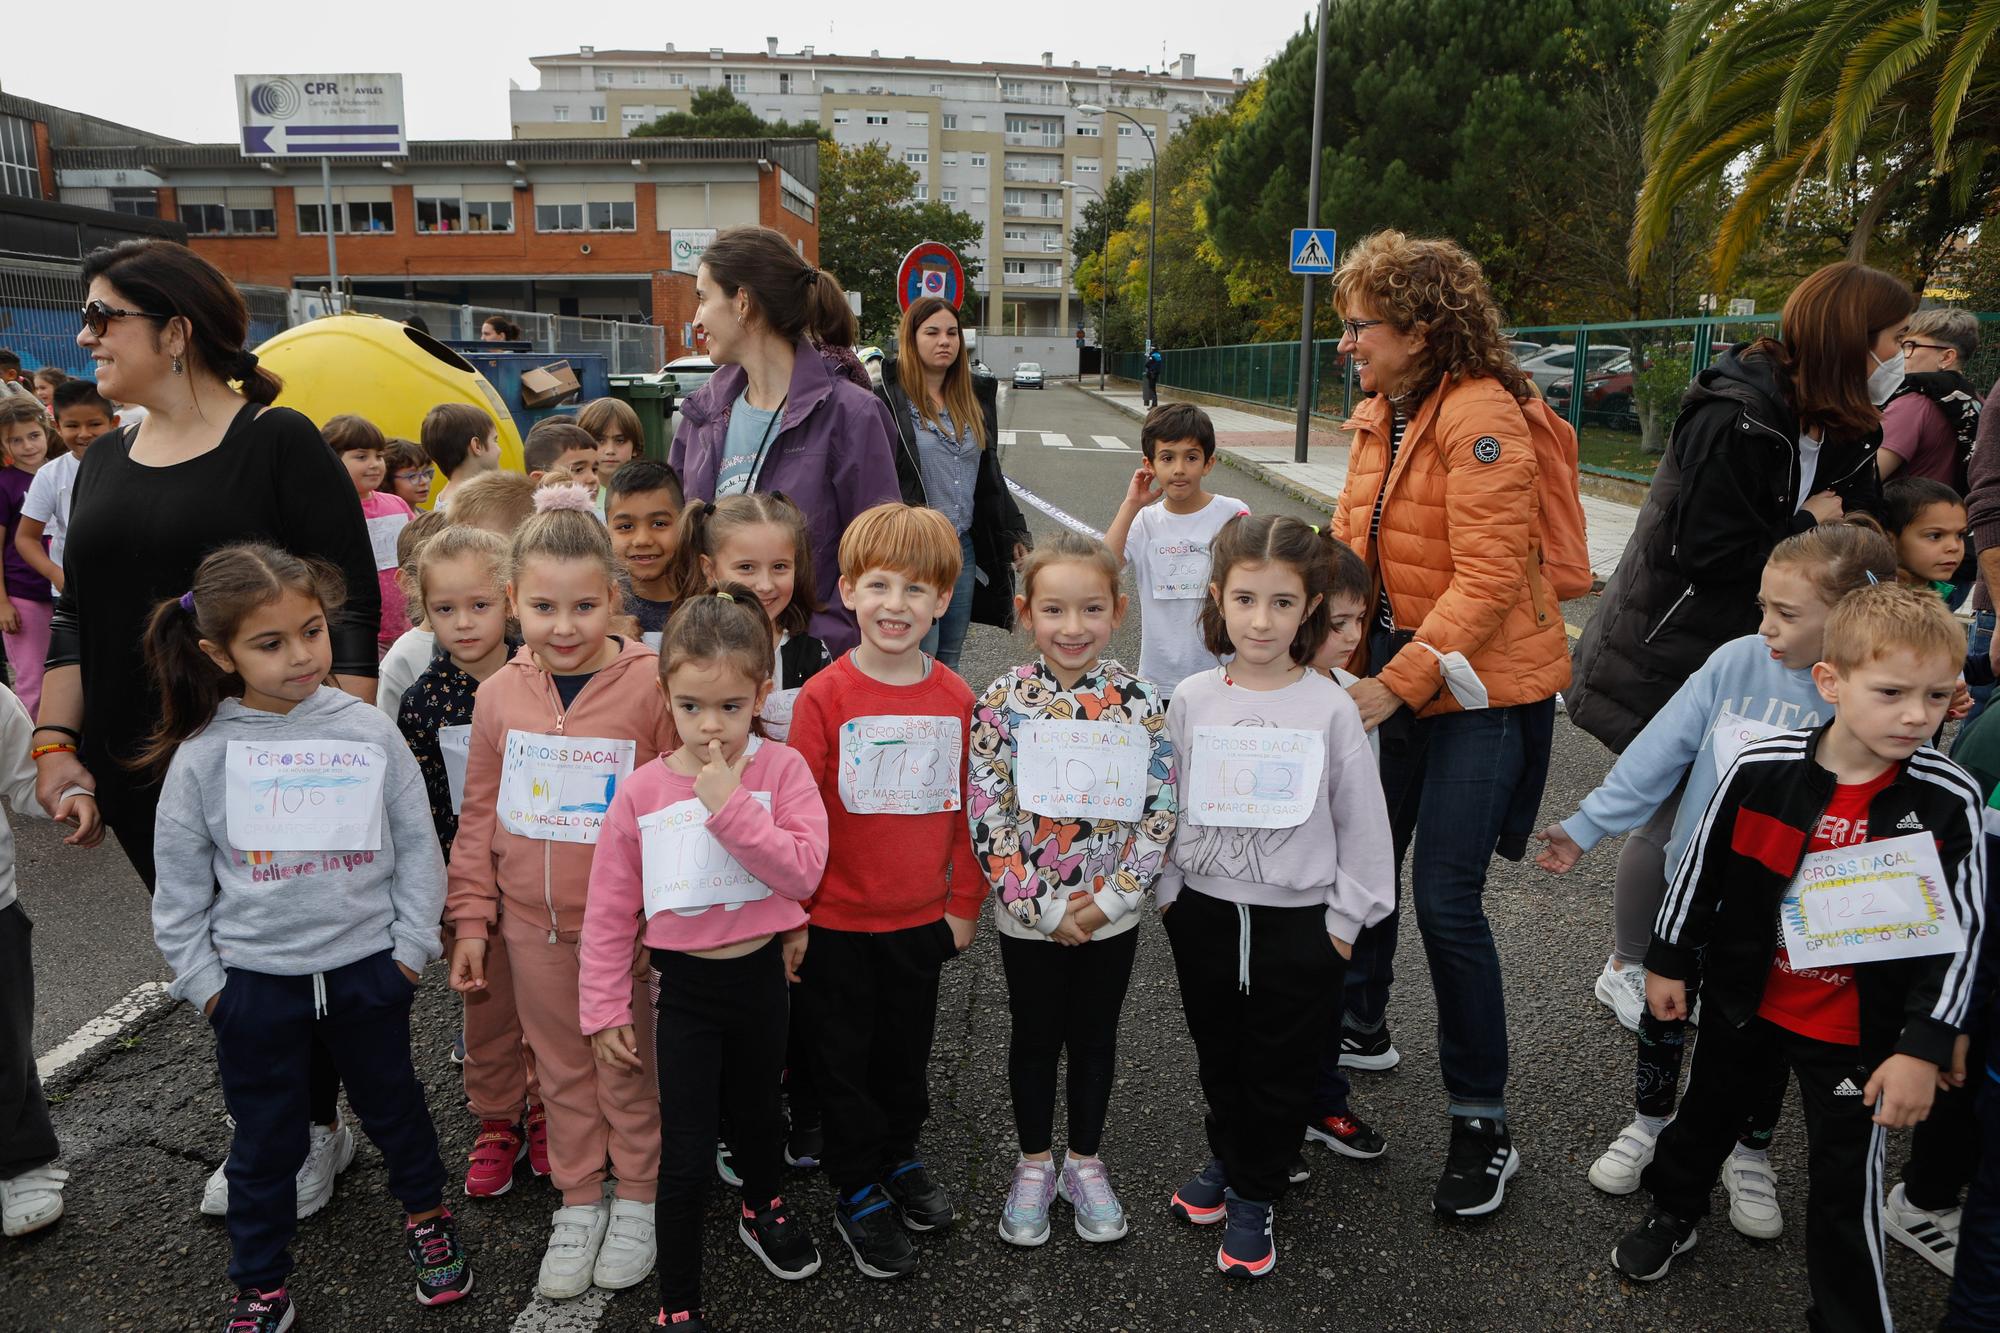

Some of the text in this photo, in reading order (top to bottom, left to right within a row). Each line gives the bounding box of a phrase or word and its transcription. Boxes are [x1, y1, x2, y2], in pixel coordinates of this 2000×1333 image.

[305, 82, 338, 95] CPR
[1160, 545, 1188, 555] CROSS
[866, 727, 914, 740] CROSS
[1033, 731, 1037, 744] I
[1041, 731, 1089, 744] CROSS
[1092, 733, 1131, 747] DACAL
[1212, 739, 1258, 751] CROSS
[257, 752, 315, 766] CROSS
[320, 752, 370, 767] DACAL
[527, 745, 568, 762] CROSS
[573, 750, 620, 764] DACAL
[869, 747, 940, 789] 113
[1046, 756, 1120, 793] 104
[264, 777, 326, 817] 106
[873, 789, 925, 800] MARCELO
[926, 788, 950, 799] GAGO
[1033, 793, 1133, 808] CP MARCELO GAGO
[1201, 801, 1215, 813] CP
[1217, 802, 1270, 814] MARCELO
[510, 810, 523, 821] CP
[525, 813, 580, 827] MARCELO
[660, 808, 702, 832] CROSS
[1896, 821, 1924, 831] adidas
[252, 850, 375, 882] believe in you
[1802, 852, 1916, 881] CROSS DACAL
[664, 877, 722, 894] MARCELO
[1822, 892, 1887, 926] 122
[1806, 924, 1940, 951] CP MARCELO GAGO
[1773, 956, 1818, 979] NEVER
[1833, 1088, 1863, 1096] adidas
[414, 1224, 435, 1239] Star!
[247, 1302, 272, 1313] Star!
